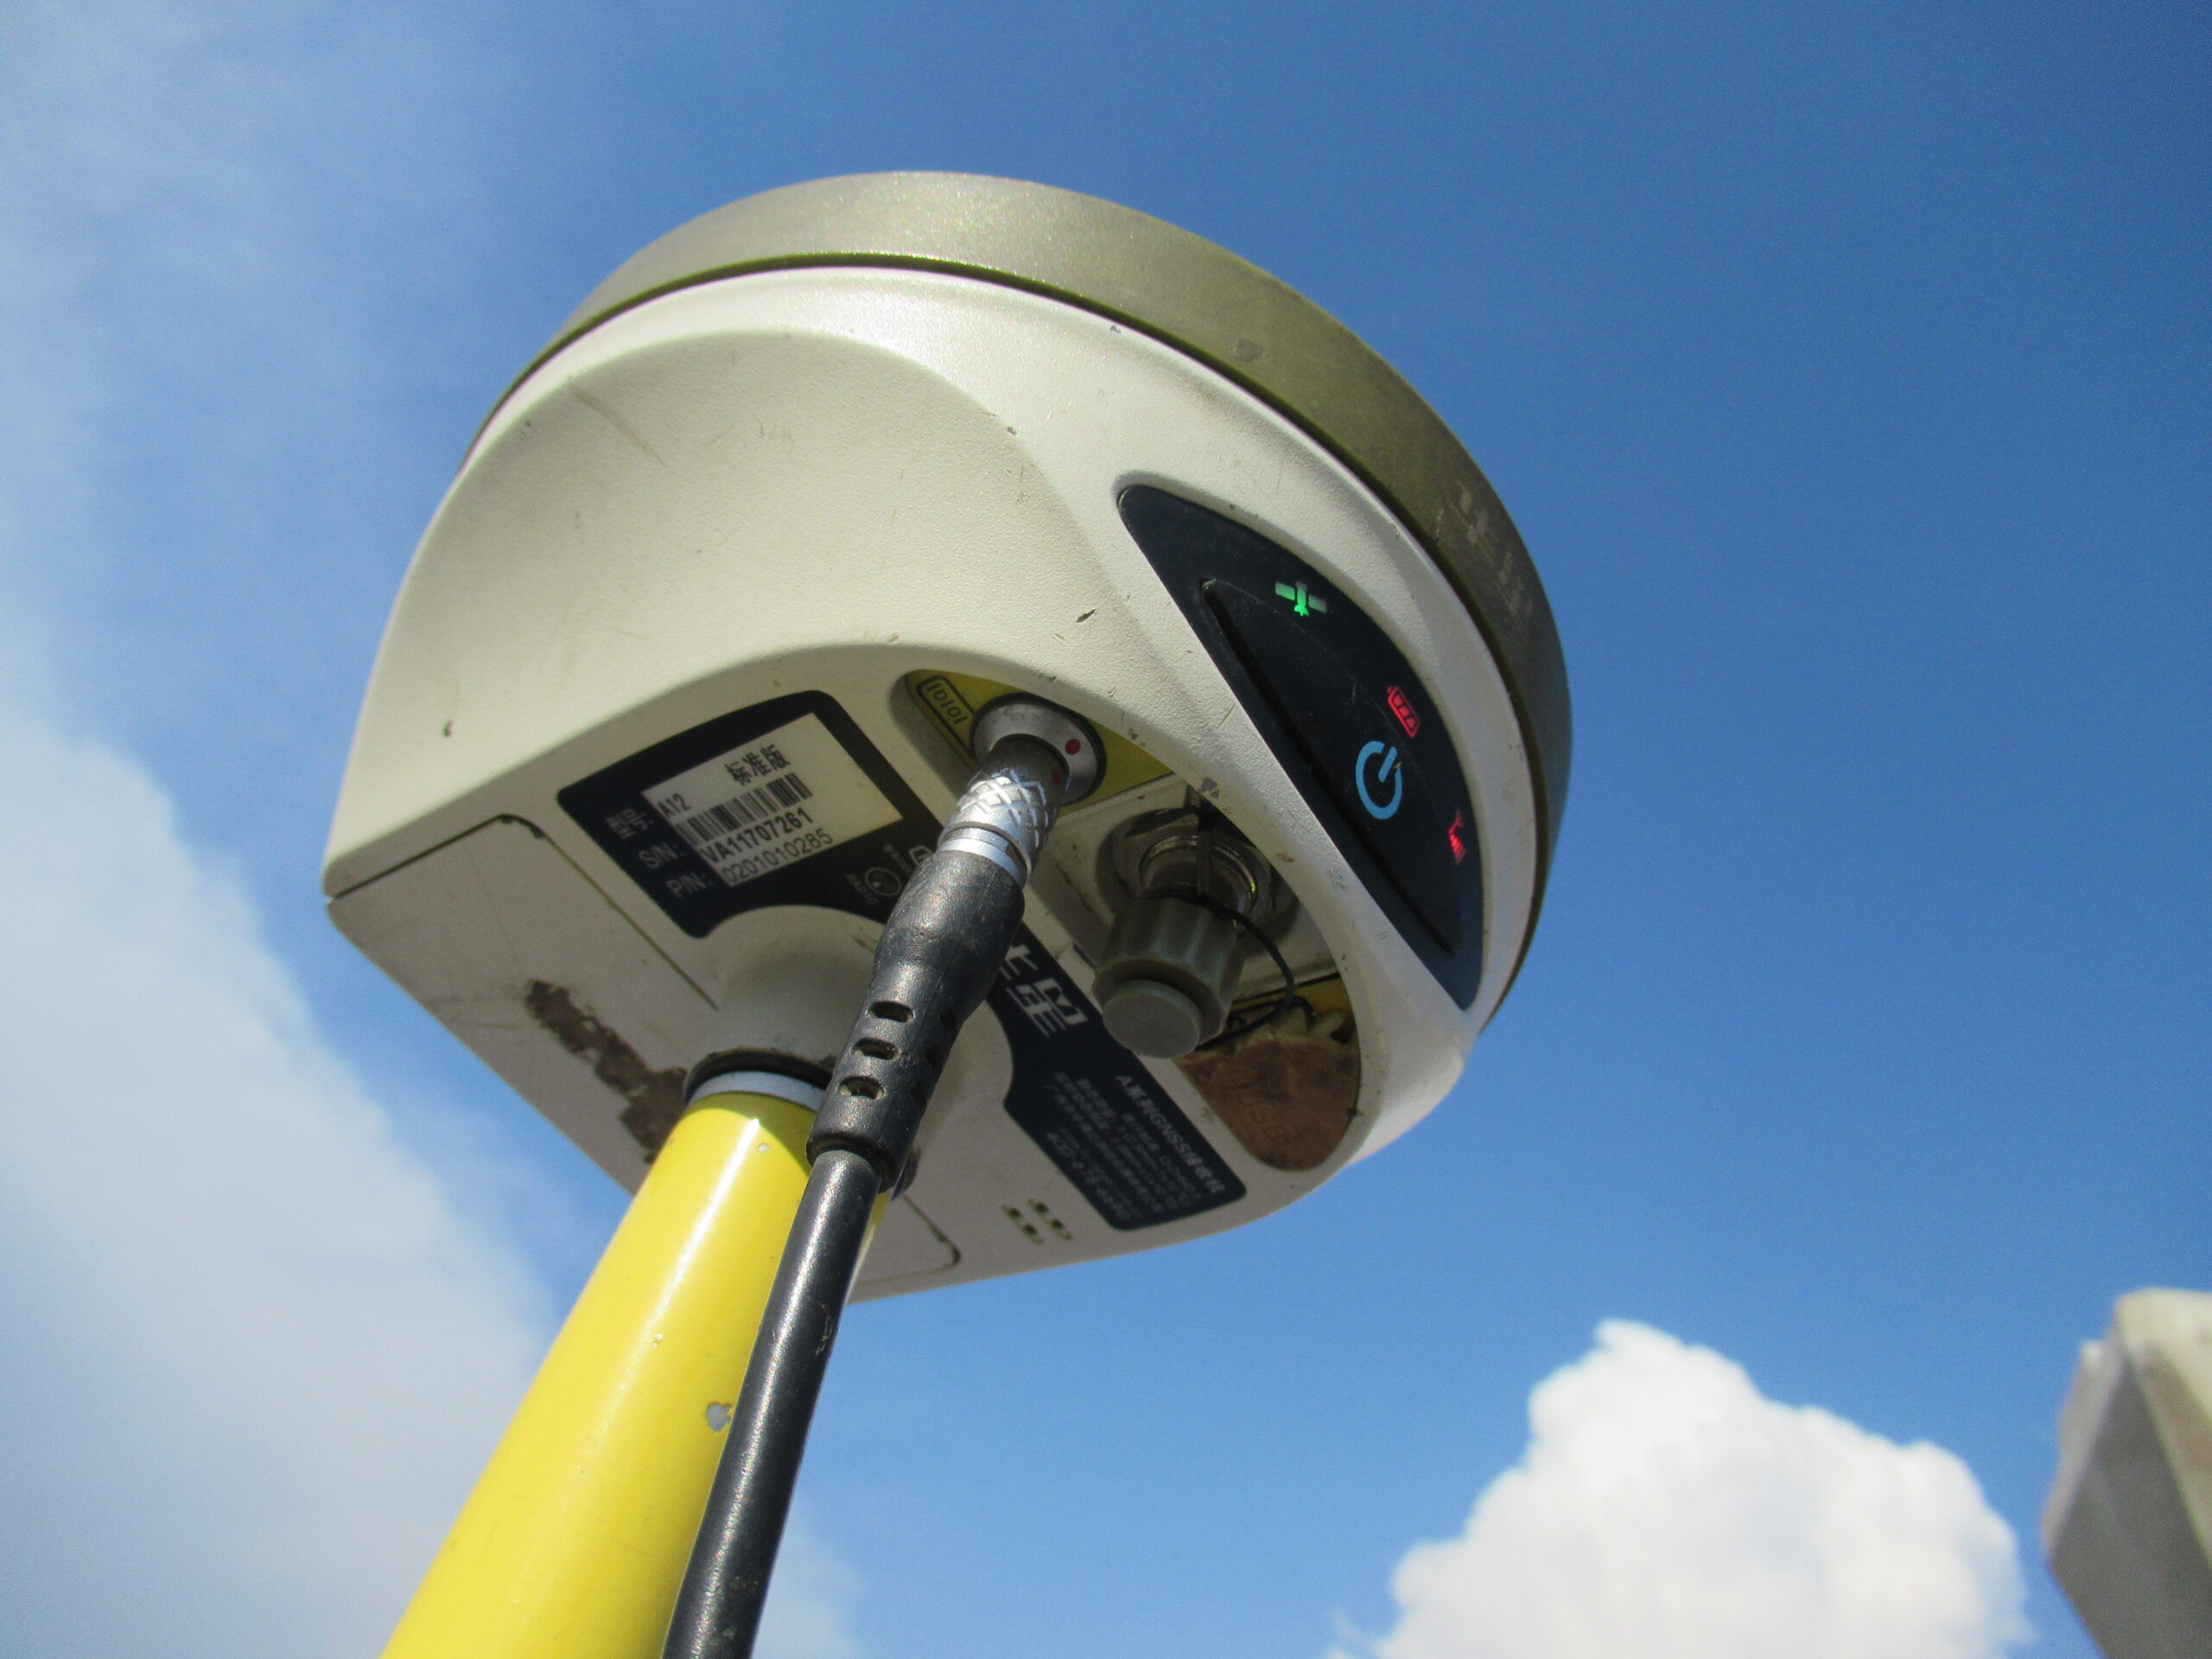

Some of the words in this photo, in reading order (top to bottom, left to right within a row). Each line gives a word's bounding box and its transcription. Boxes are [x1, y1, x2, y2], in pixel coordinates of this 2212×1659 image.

[724, 743, 791, 787] 标准版
[657, 792, 691, 819] A12
[699, 806, 814, 864] VA11707261
[721, 827, 834, 883] 0201010285
